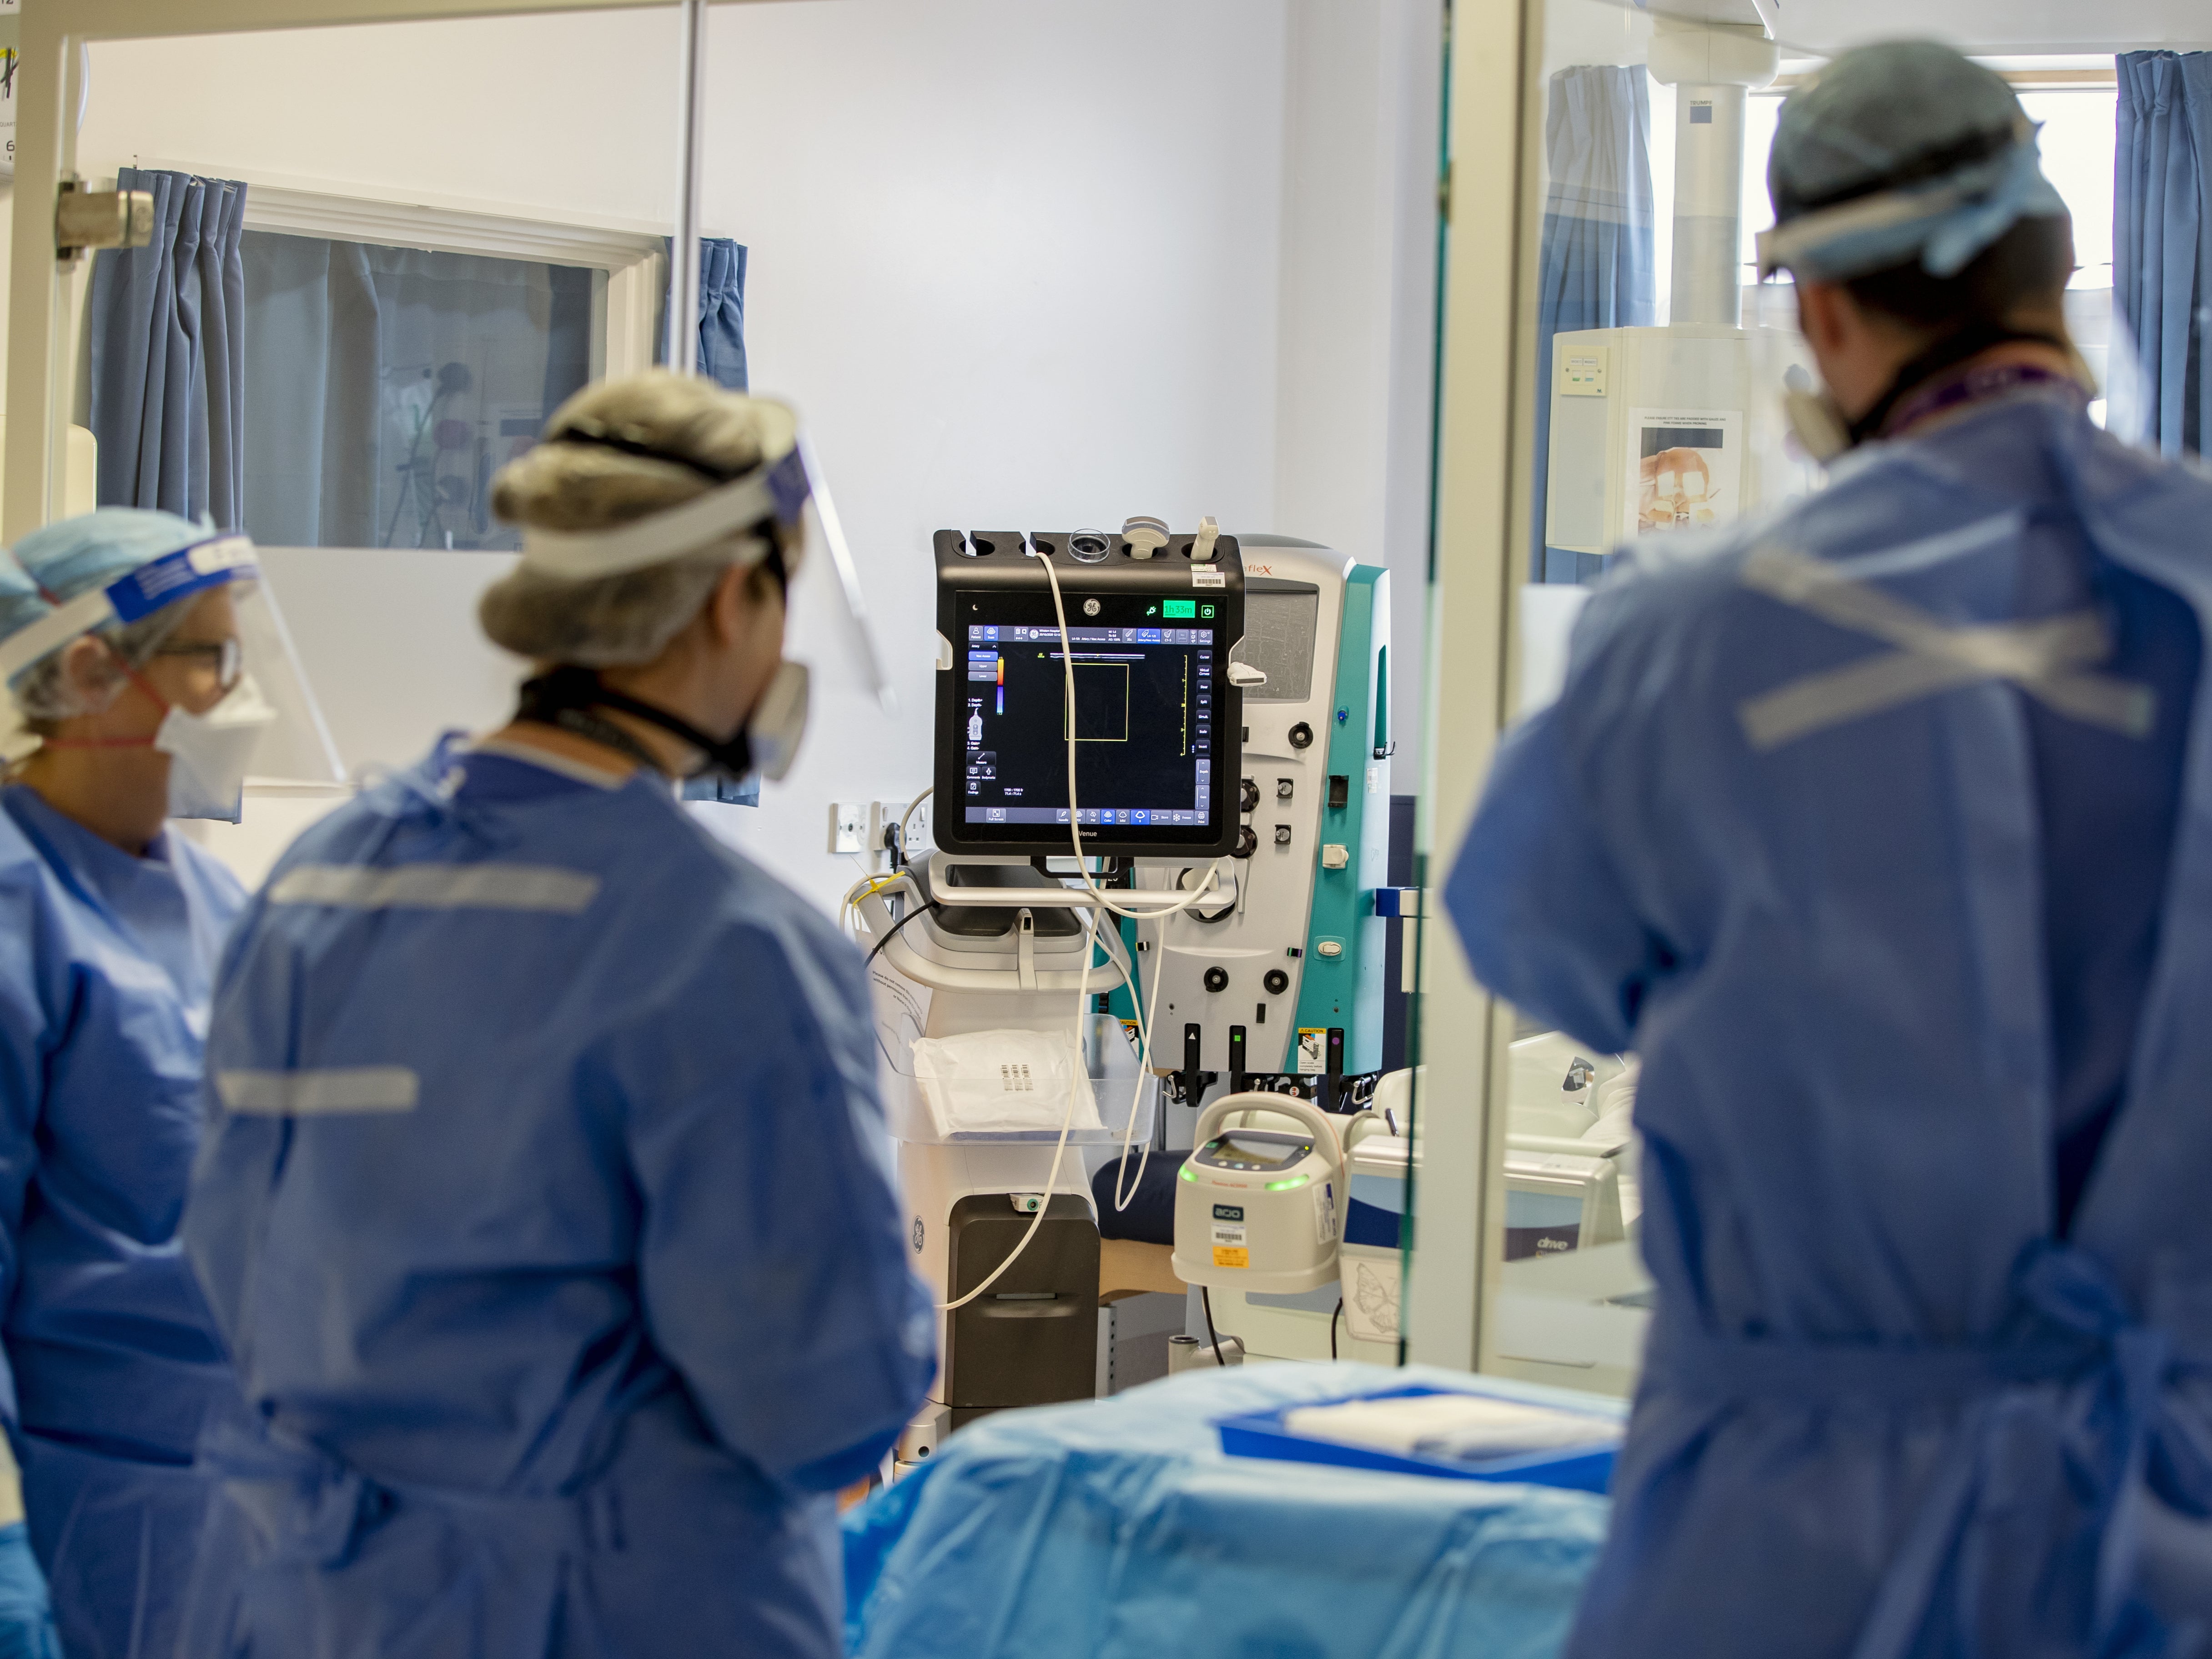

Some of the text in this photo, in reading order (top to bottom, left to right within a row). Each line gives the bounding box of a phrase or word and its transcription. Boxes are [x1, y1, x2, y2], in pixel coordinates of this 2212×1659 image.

[6, 140, 15, 151] 6
[873, 978, 886, 986] without
[887, 984, 903, 996] permission
[895, 982, 905, 991] remove
